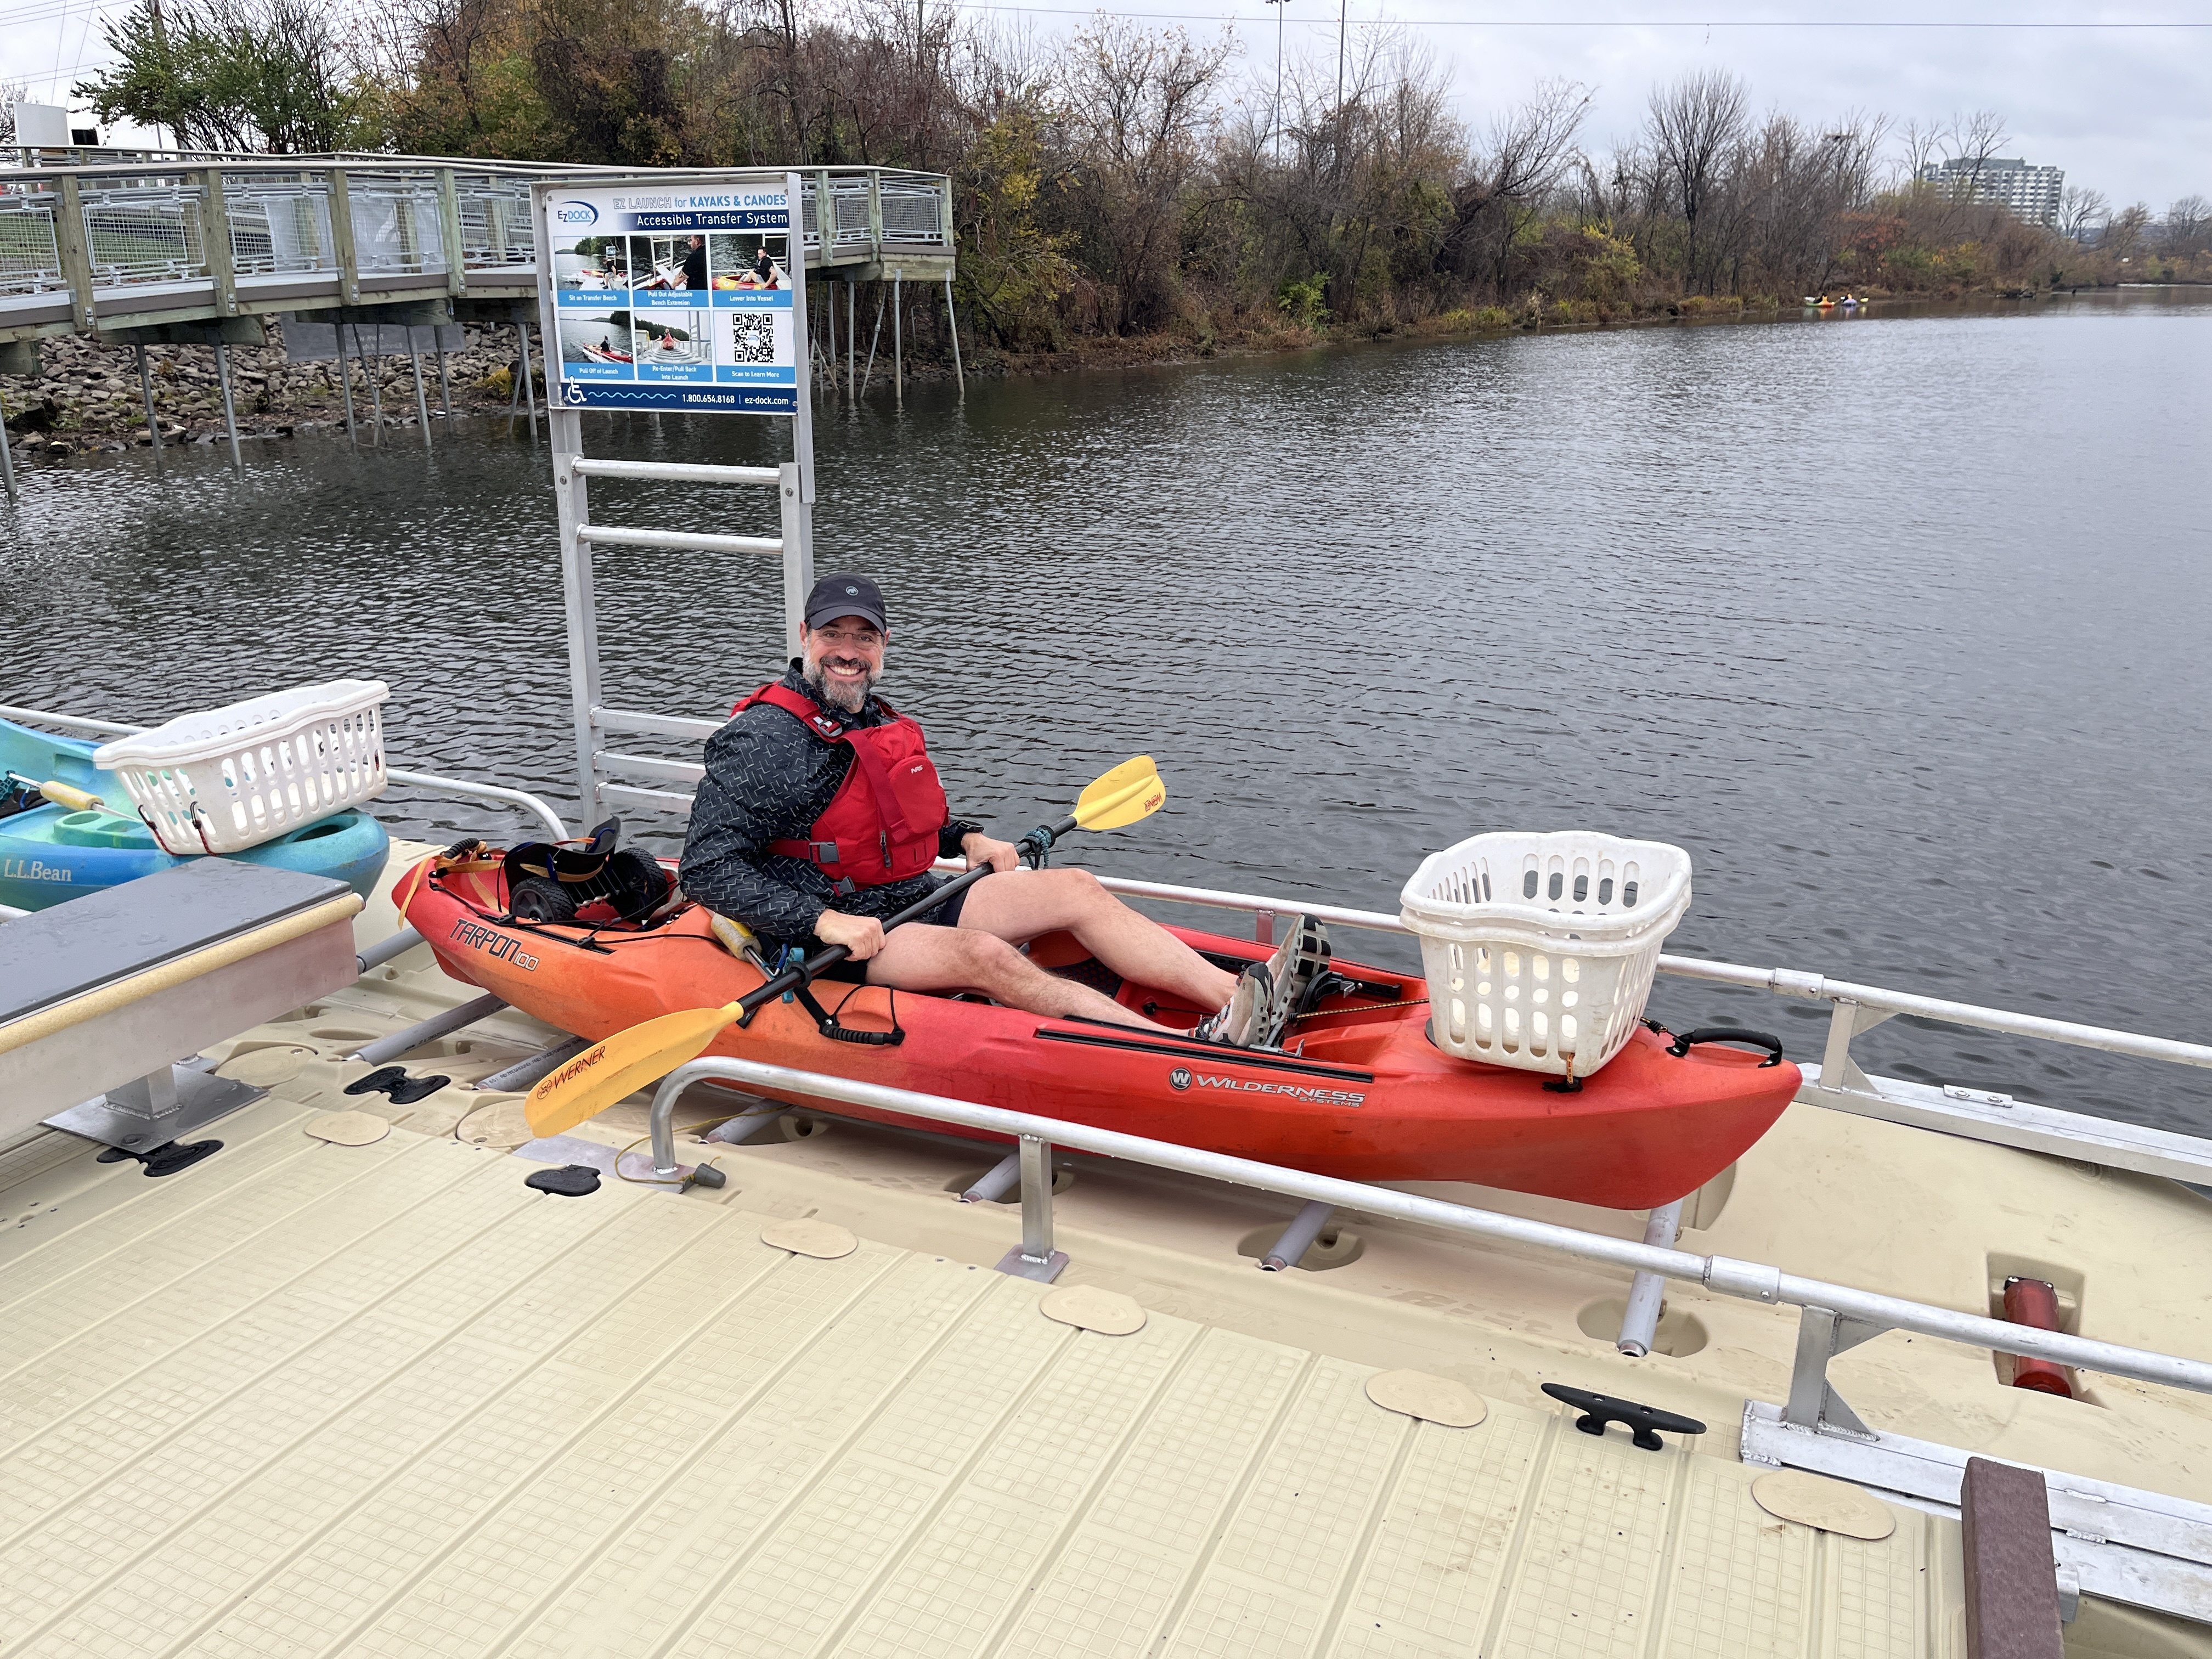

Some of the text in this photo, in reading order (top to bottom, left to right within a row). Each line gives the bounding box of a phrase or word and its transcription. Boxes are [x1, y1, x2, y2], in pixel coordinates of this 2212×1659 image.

[613, 194, 787, 210] EZ LAUNCH for KAYAKS & CANOES
[637, 212, 787, 226] Accessible Transfer System
[682, 394, 789, 405] 1.800.654.8168 ez-dock.com
[4, 859, 72, 882] L.L.Bean
[449, 918, 540, 972] TARPON 100
[554, 1045, 606, 1090] WERNER
[1196, 1074, 1366, 1103] WILDERNESS
[1299, 1096, 1361, 1108] SYSTEMS
